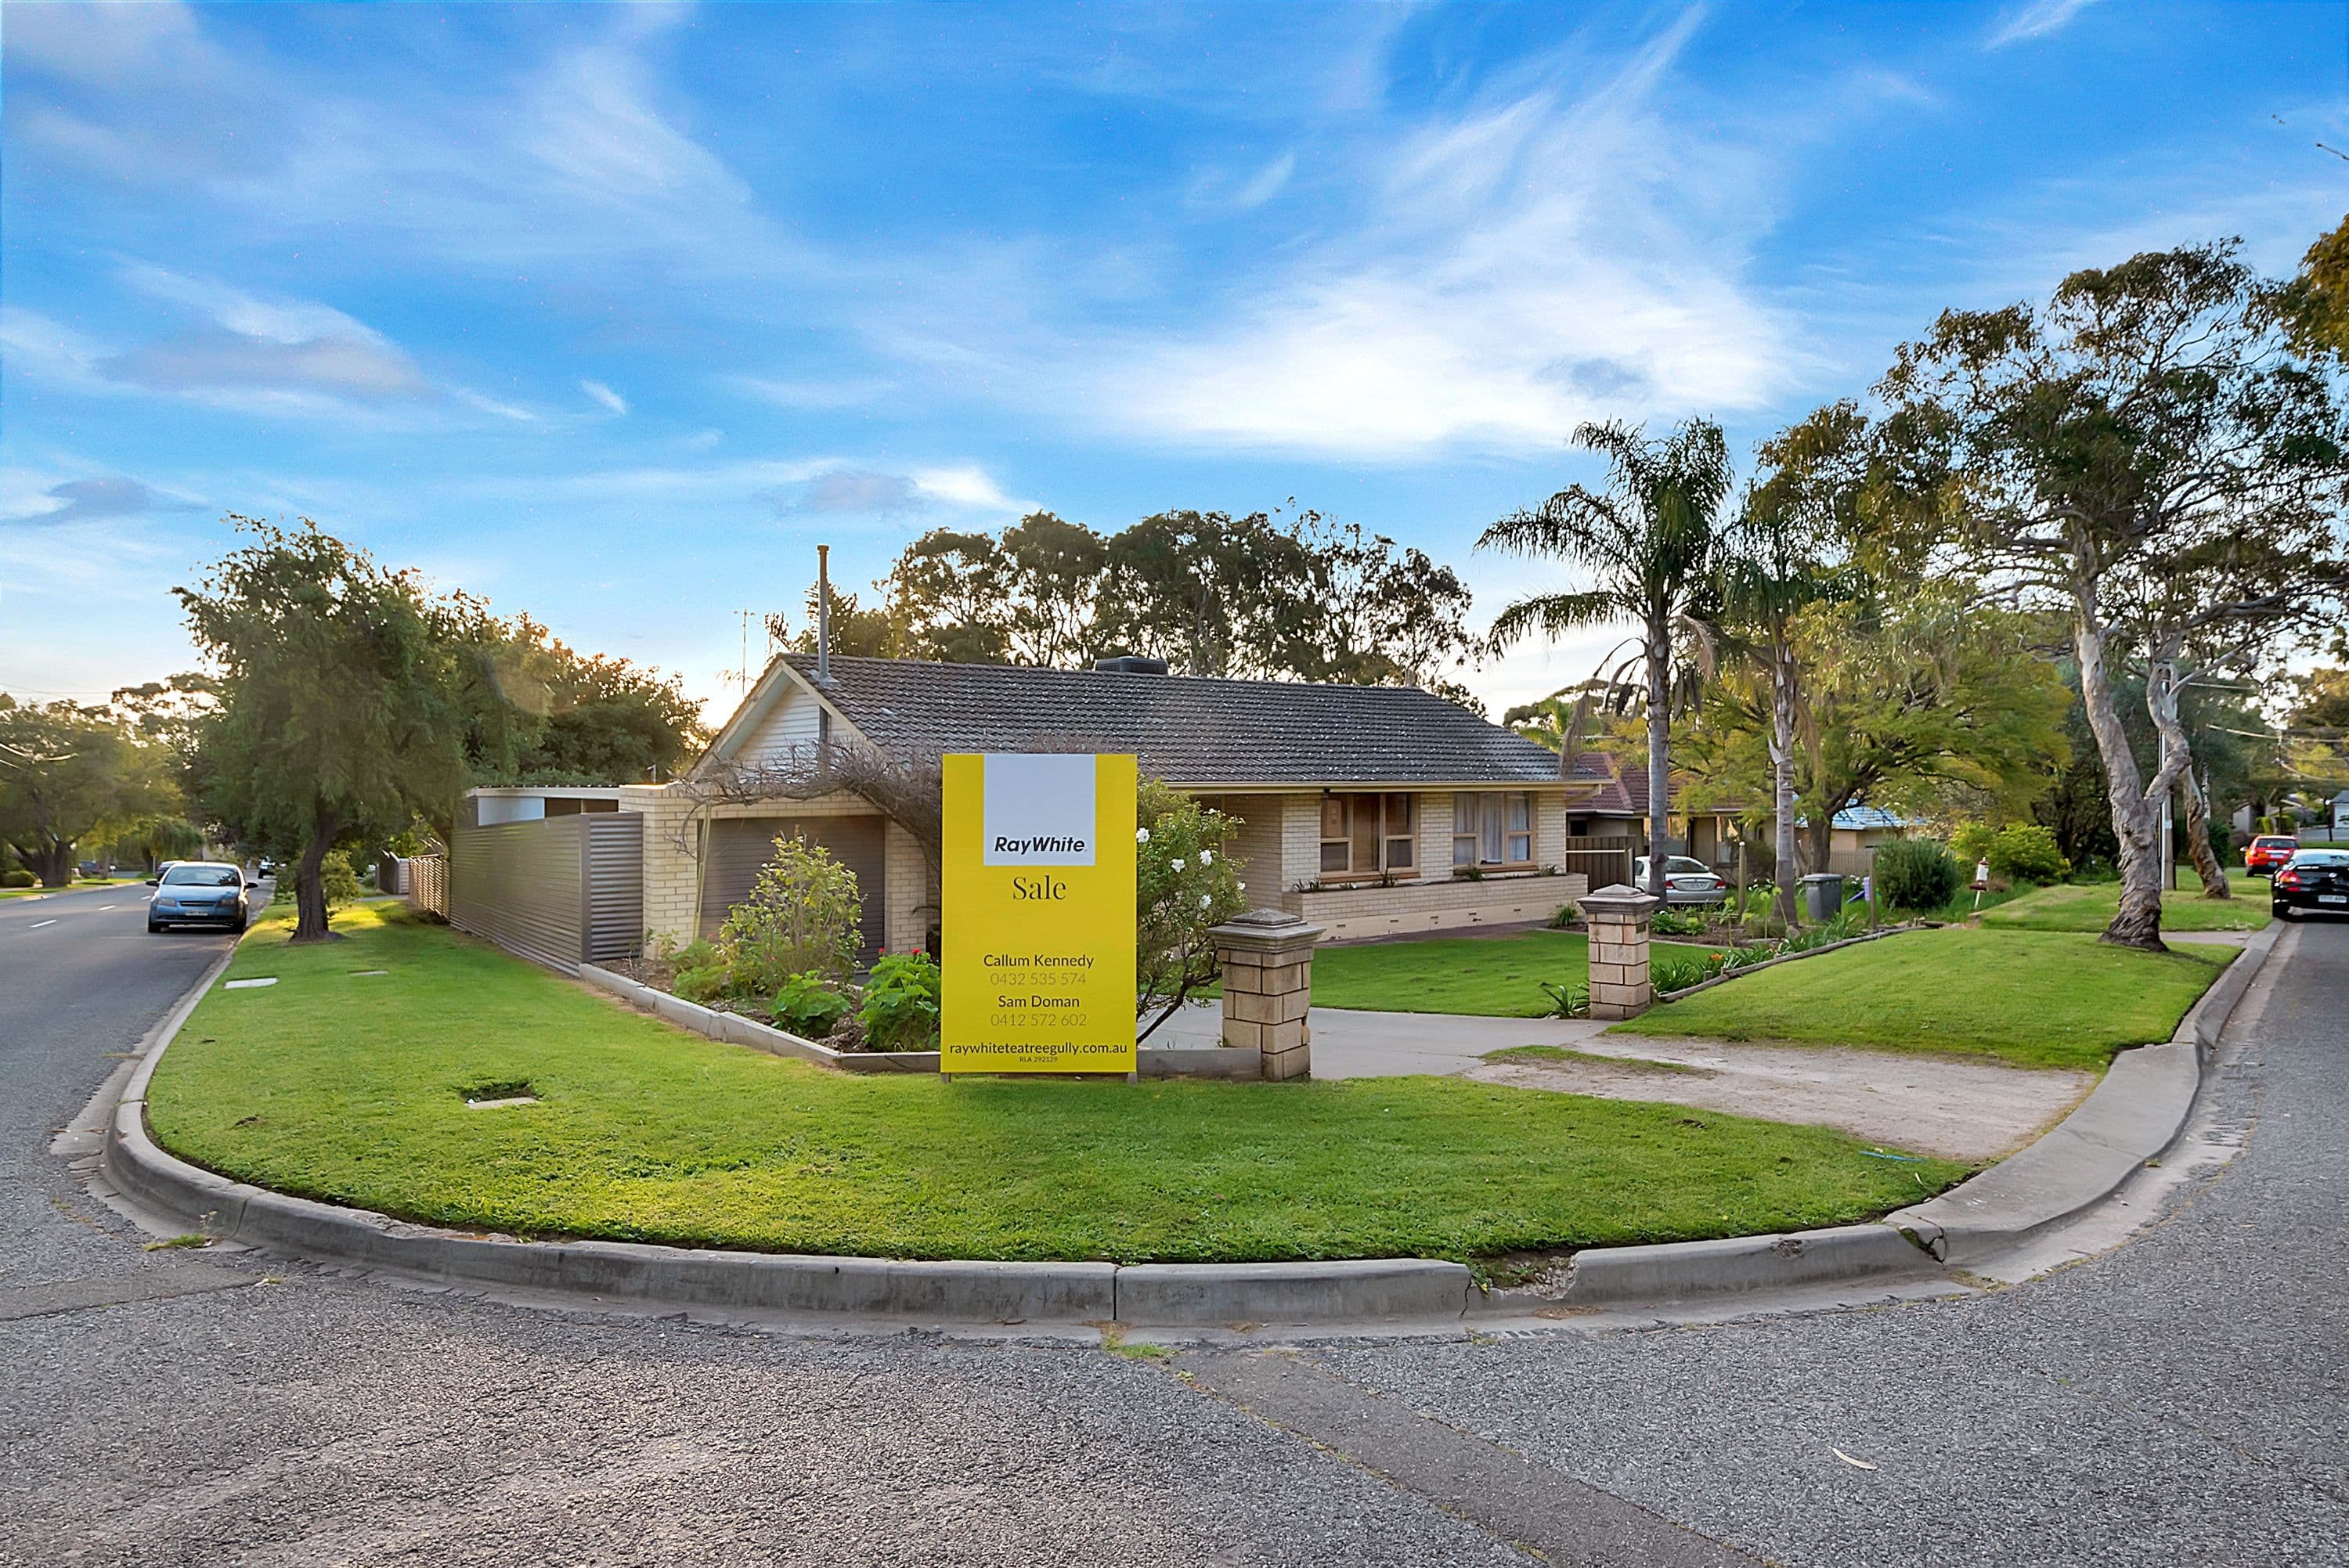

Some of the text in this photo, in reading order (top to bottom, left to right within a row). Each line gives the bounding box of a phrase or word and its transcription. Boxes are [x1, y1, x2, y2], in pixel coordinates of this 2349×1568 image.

[1012, 875, 1066, 900] Sale
[983, 954, 1094, 969] Callum Kennedy
[990, 972, 1086, 986] 0432 535 574
[998, 995, 1080, 1007] Sam Doman
[990, 1014, 1087, 1026] 0412 572 602
[950, 1042, 1128, 1056] raywhiteteatreegully.com.au
